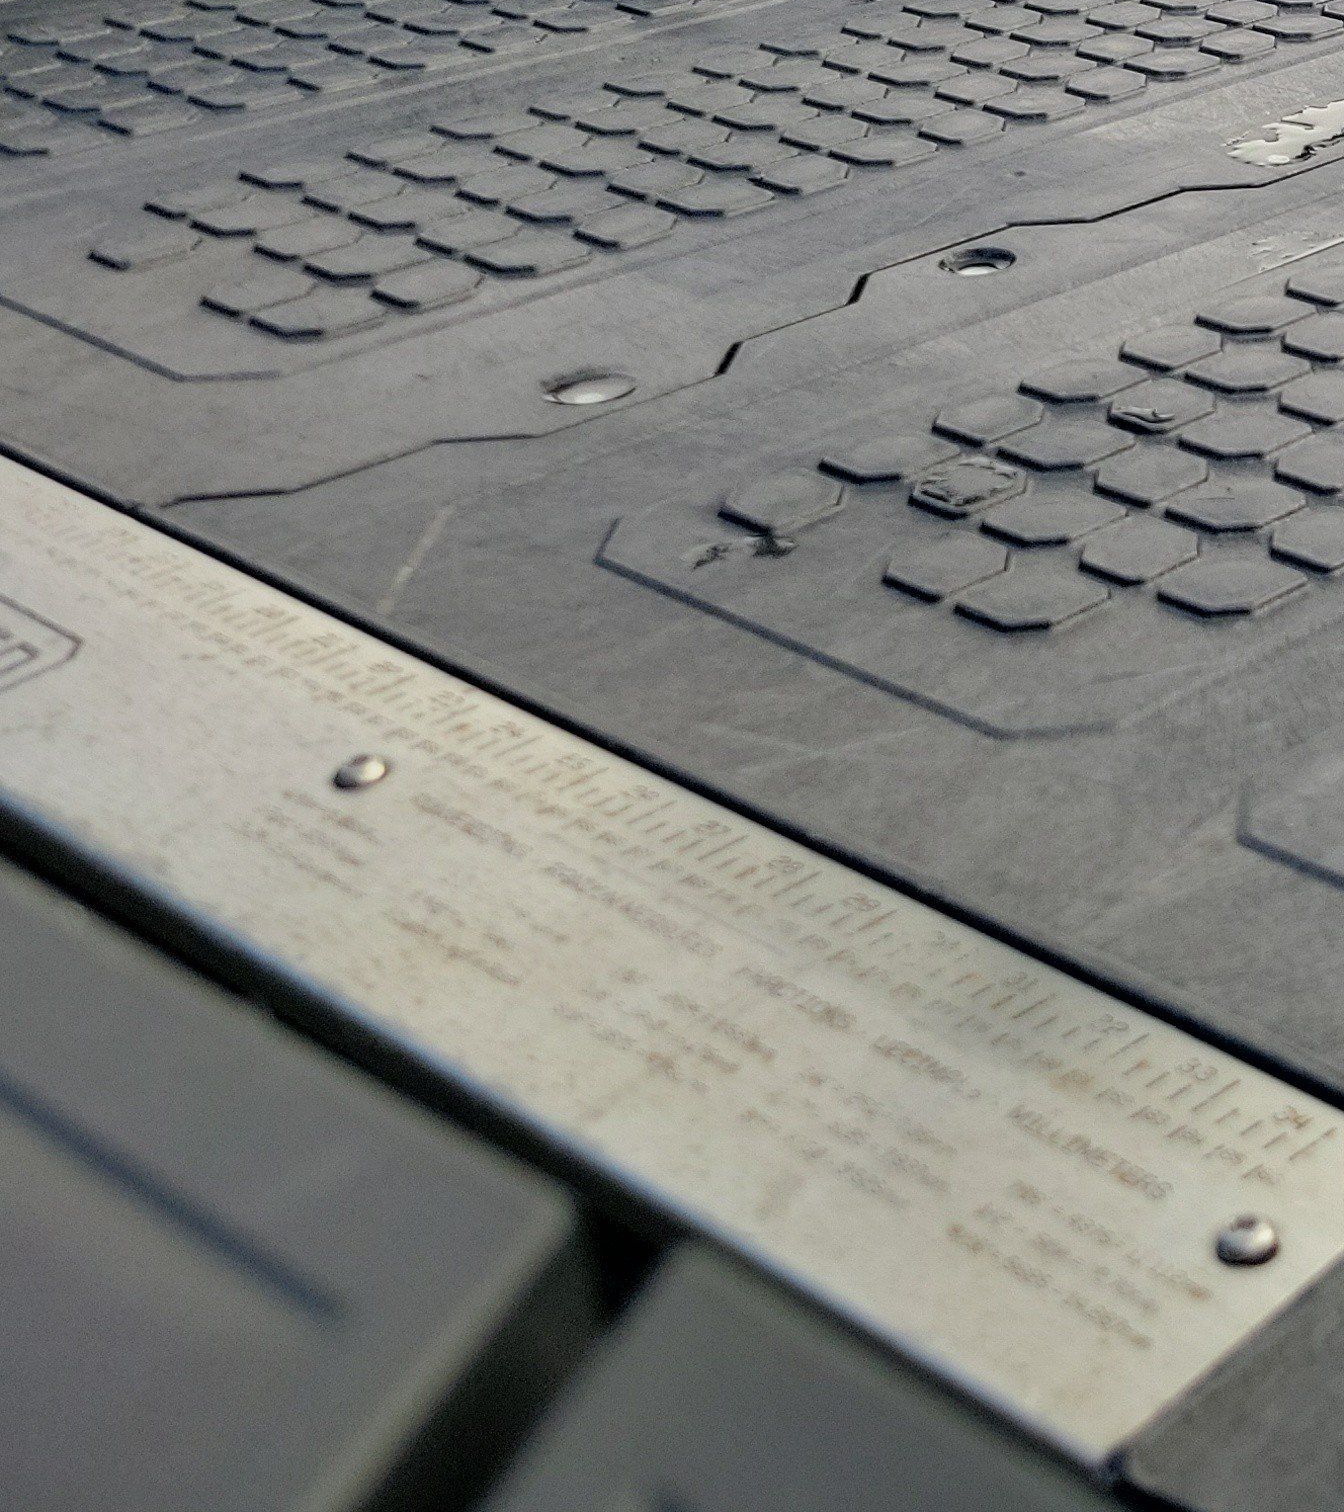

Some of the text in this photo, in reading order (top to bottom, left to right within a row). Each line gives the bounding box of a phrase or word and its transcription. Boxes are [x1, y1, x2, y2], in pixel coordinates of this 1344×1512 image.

[1173, 1057, 1223, 1083] 33
[1268, 1106, 1316, 1131] 34
[997, 1103, 1182, 1203] MILLIMETERS
